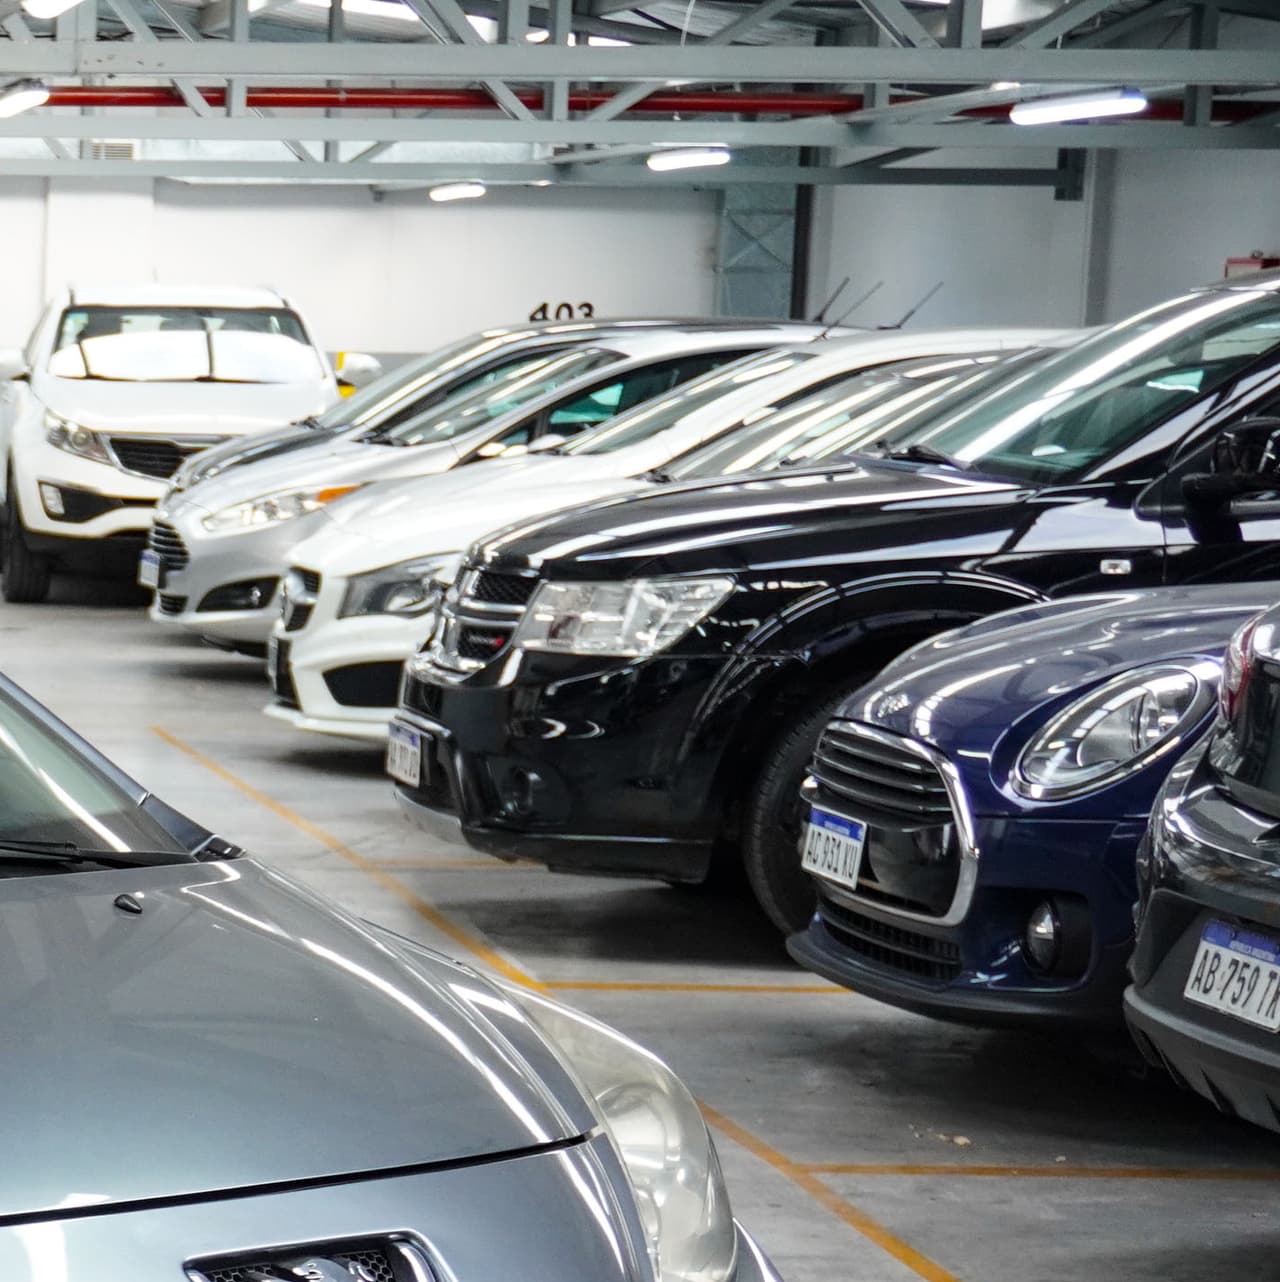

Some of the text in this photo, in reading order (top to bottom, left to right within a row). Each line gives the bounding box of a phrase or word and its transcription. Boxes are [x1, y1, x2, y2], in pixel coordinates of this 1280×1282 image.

[529, 302, 594, 321] 403
[1191, 949, 1222, 994] AB
[1220, 958, 1261, 1008] 759
